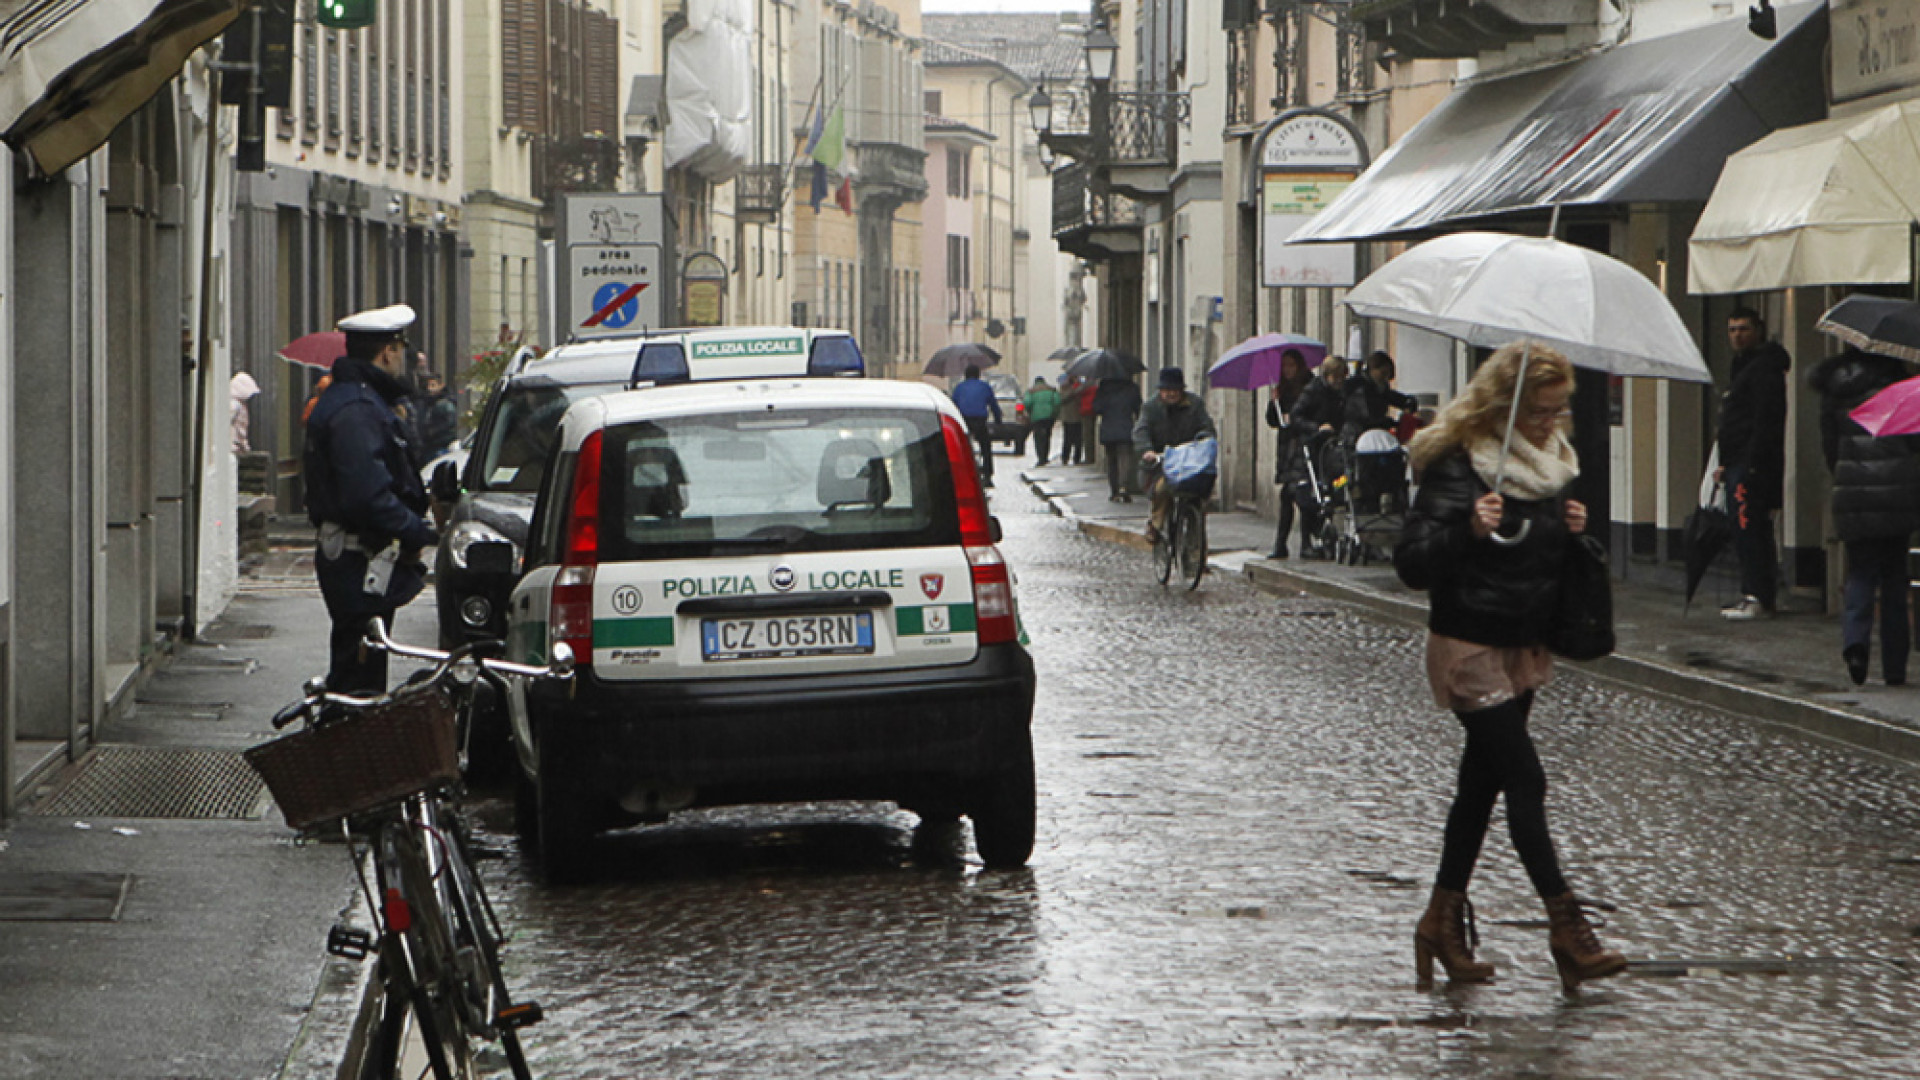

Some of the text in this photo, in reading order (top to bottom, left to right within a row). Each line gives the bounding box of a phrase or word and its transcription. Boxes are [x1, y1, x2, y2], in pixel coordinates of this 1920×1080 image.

[599, 251, 630, 259] area
[582, 264, 648, 276] pedonale
[697, 340, 797, 355] POLIZIA LOCALE
[663, 569, 905, 599] POLIZIA LOCALE
[618, 590, 637, 609] 10
[723, 617, 853, 649] CZ 063RN
[611, 649, 661, 660] Panda
